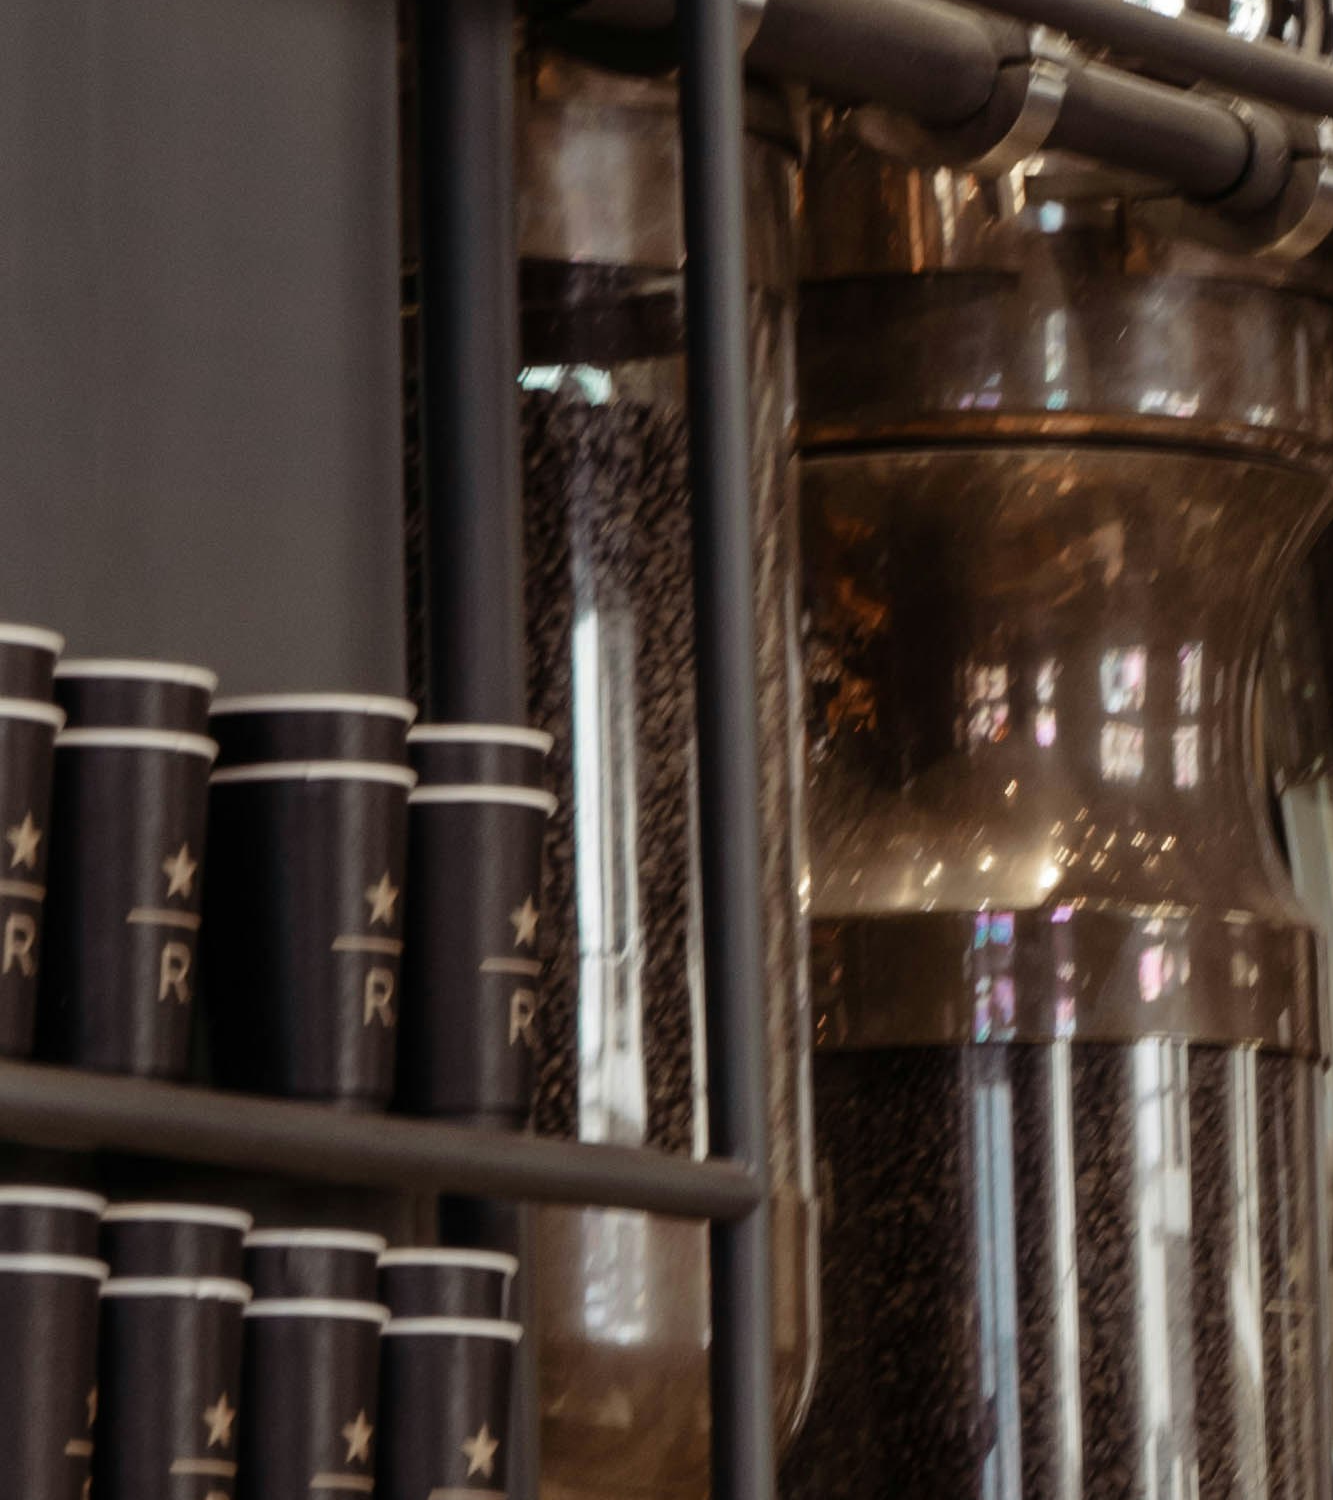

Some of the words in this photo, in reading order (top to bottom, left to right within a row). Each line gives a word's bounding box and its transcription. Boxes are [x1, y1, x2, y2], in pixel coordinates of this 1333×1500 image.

[3, 912, 36, 978] R
[158, 941, 191, 1004] R
[363, 966, 395, 1029] R
[509, 988, 537, 1047] R
